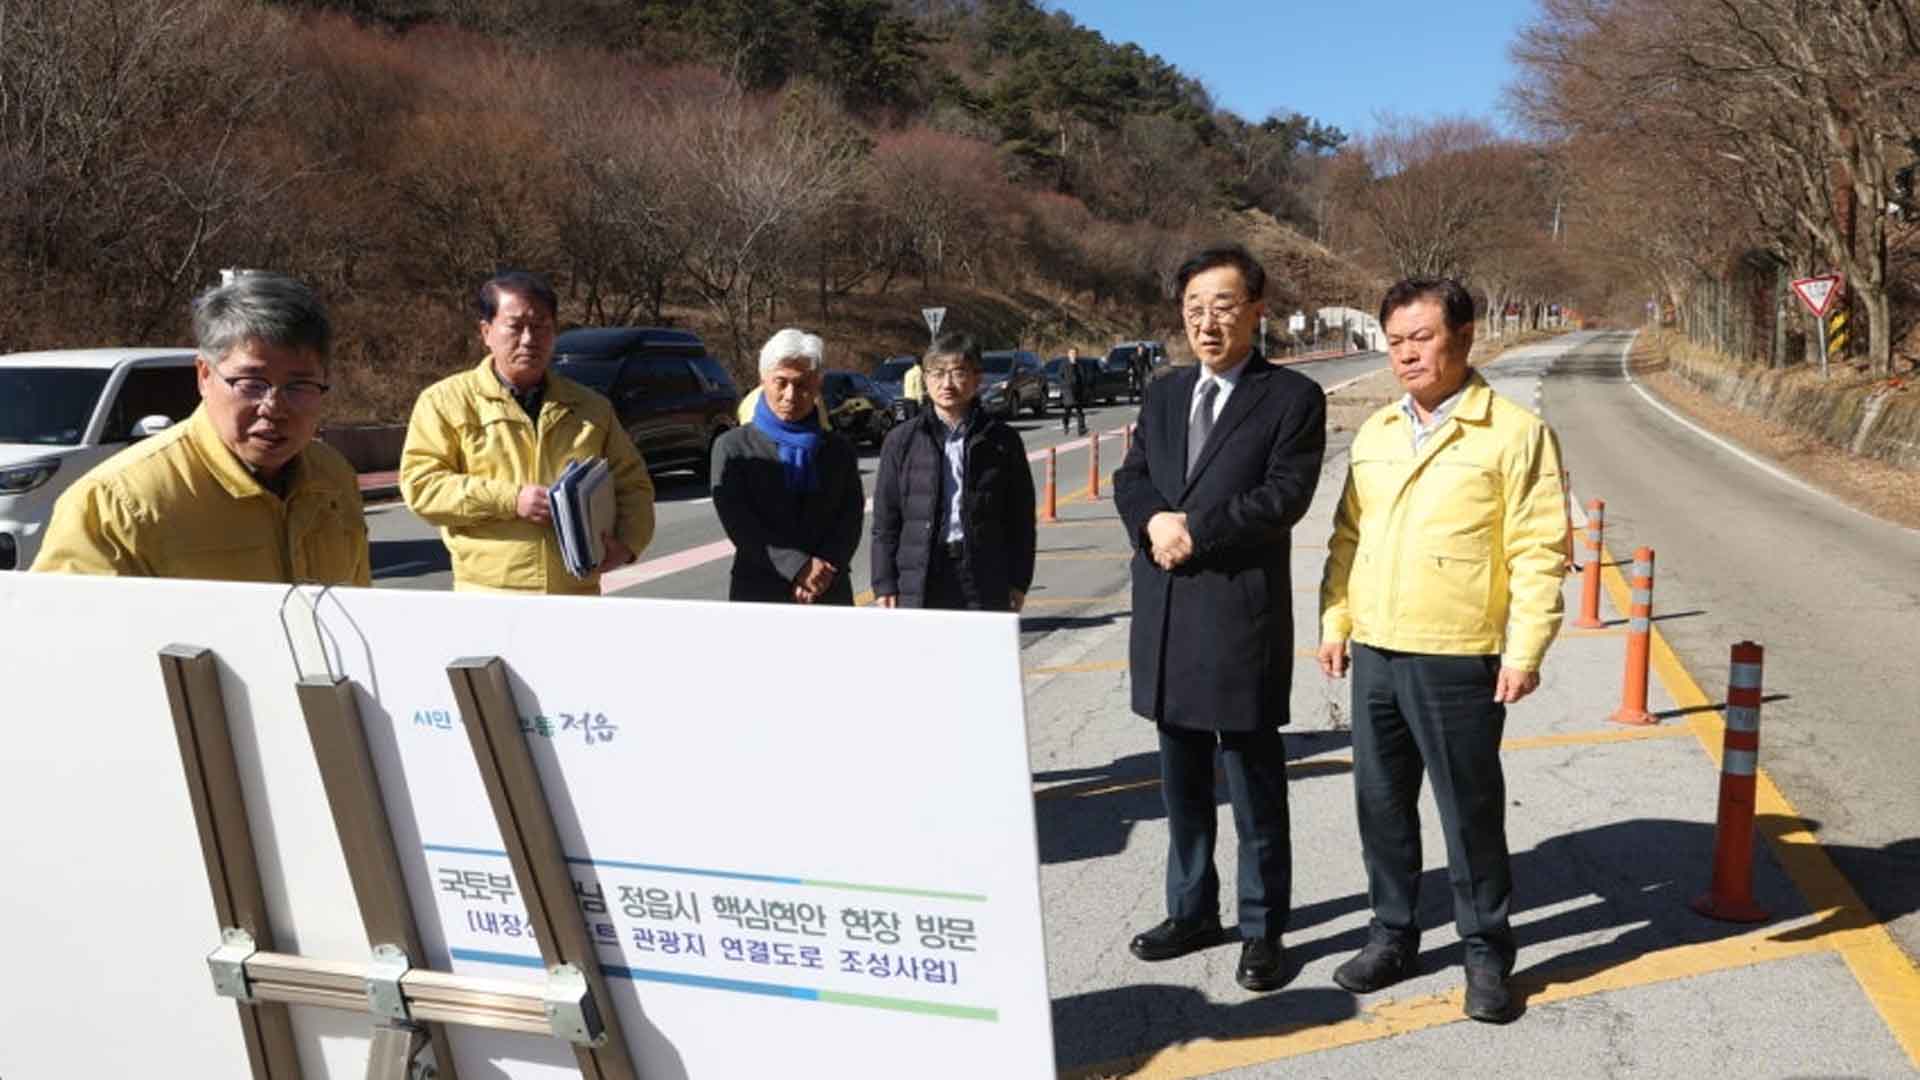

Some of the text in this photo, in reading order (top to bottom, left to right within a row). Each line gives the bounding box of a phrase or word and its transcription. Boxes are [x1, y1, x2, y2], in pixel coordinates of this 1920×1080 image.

[559, 712, 618, 744] 정읍
[438, 867, 517, 903] 국토부
[618, 884, 701, 924] 정읍시
[712, 894, 827, 937] 핵심현안
[840, 907, 901, 945] 현장
[915, 914, 977, 952] 방문
[632, 927, 705, 957] 관광지
[721, 936, 825, 970] 연결도로
[839, 949, 959, 985] 조성사업]
